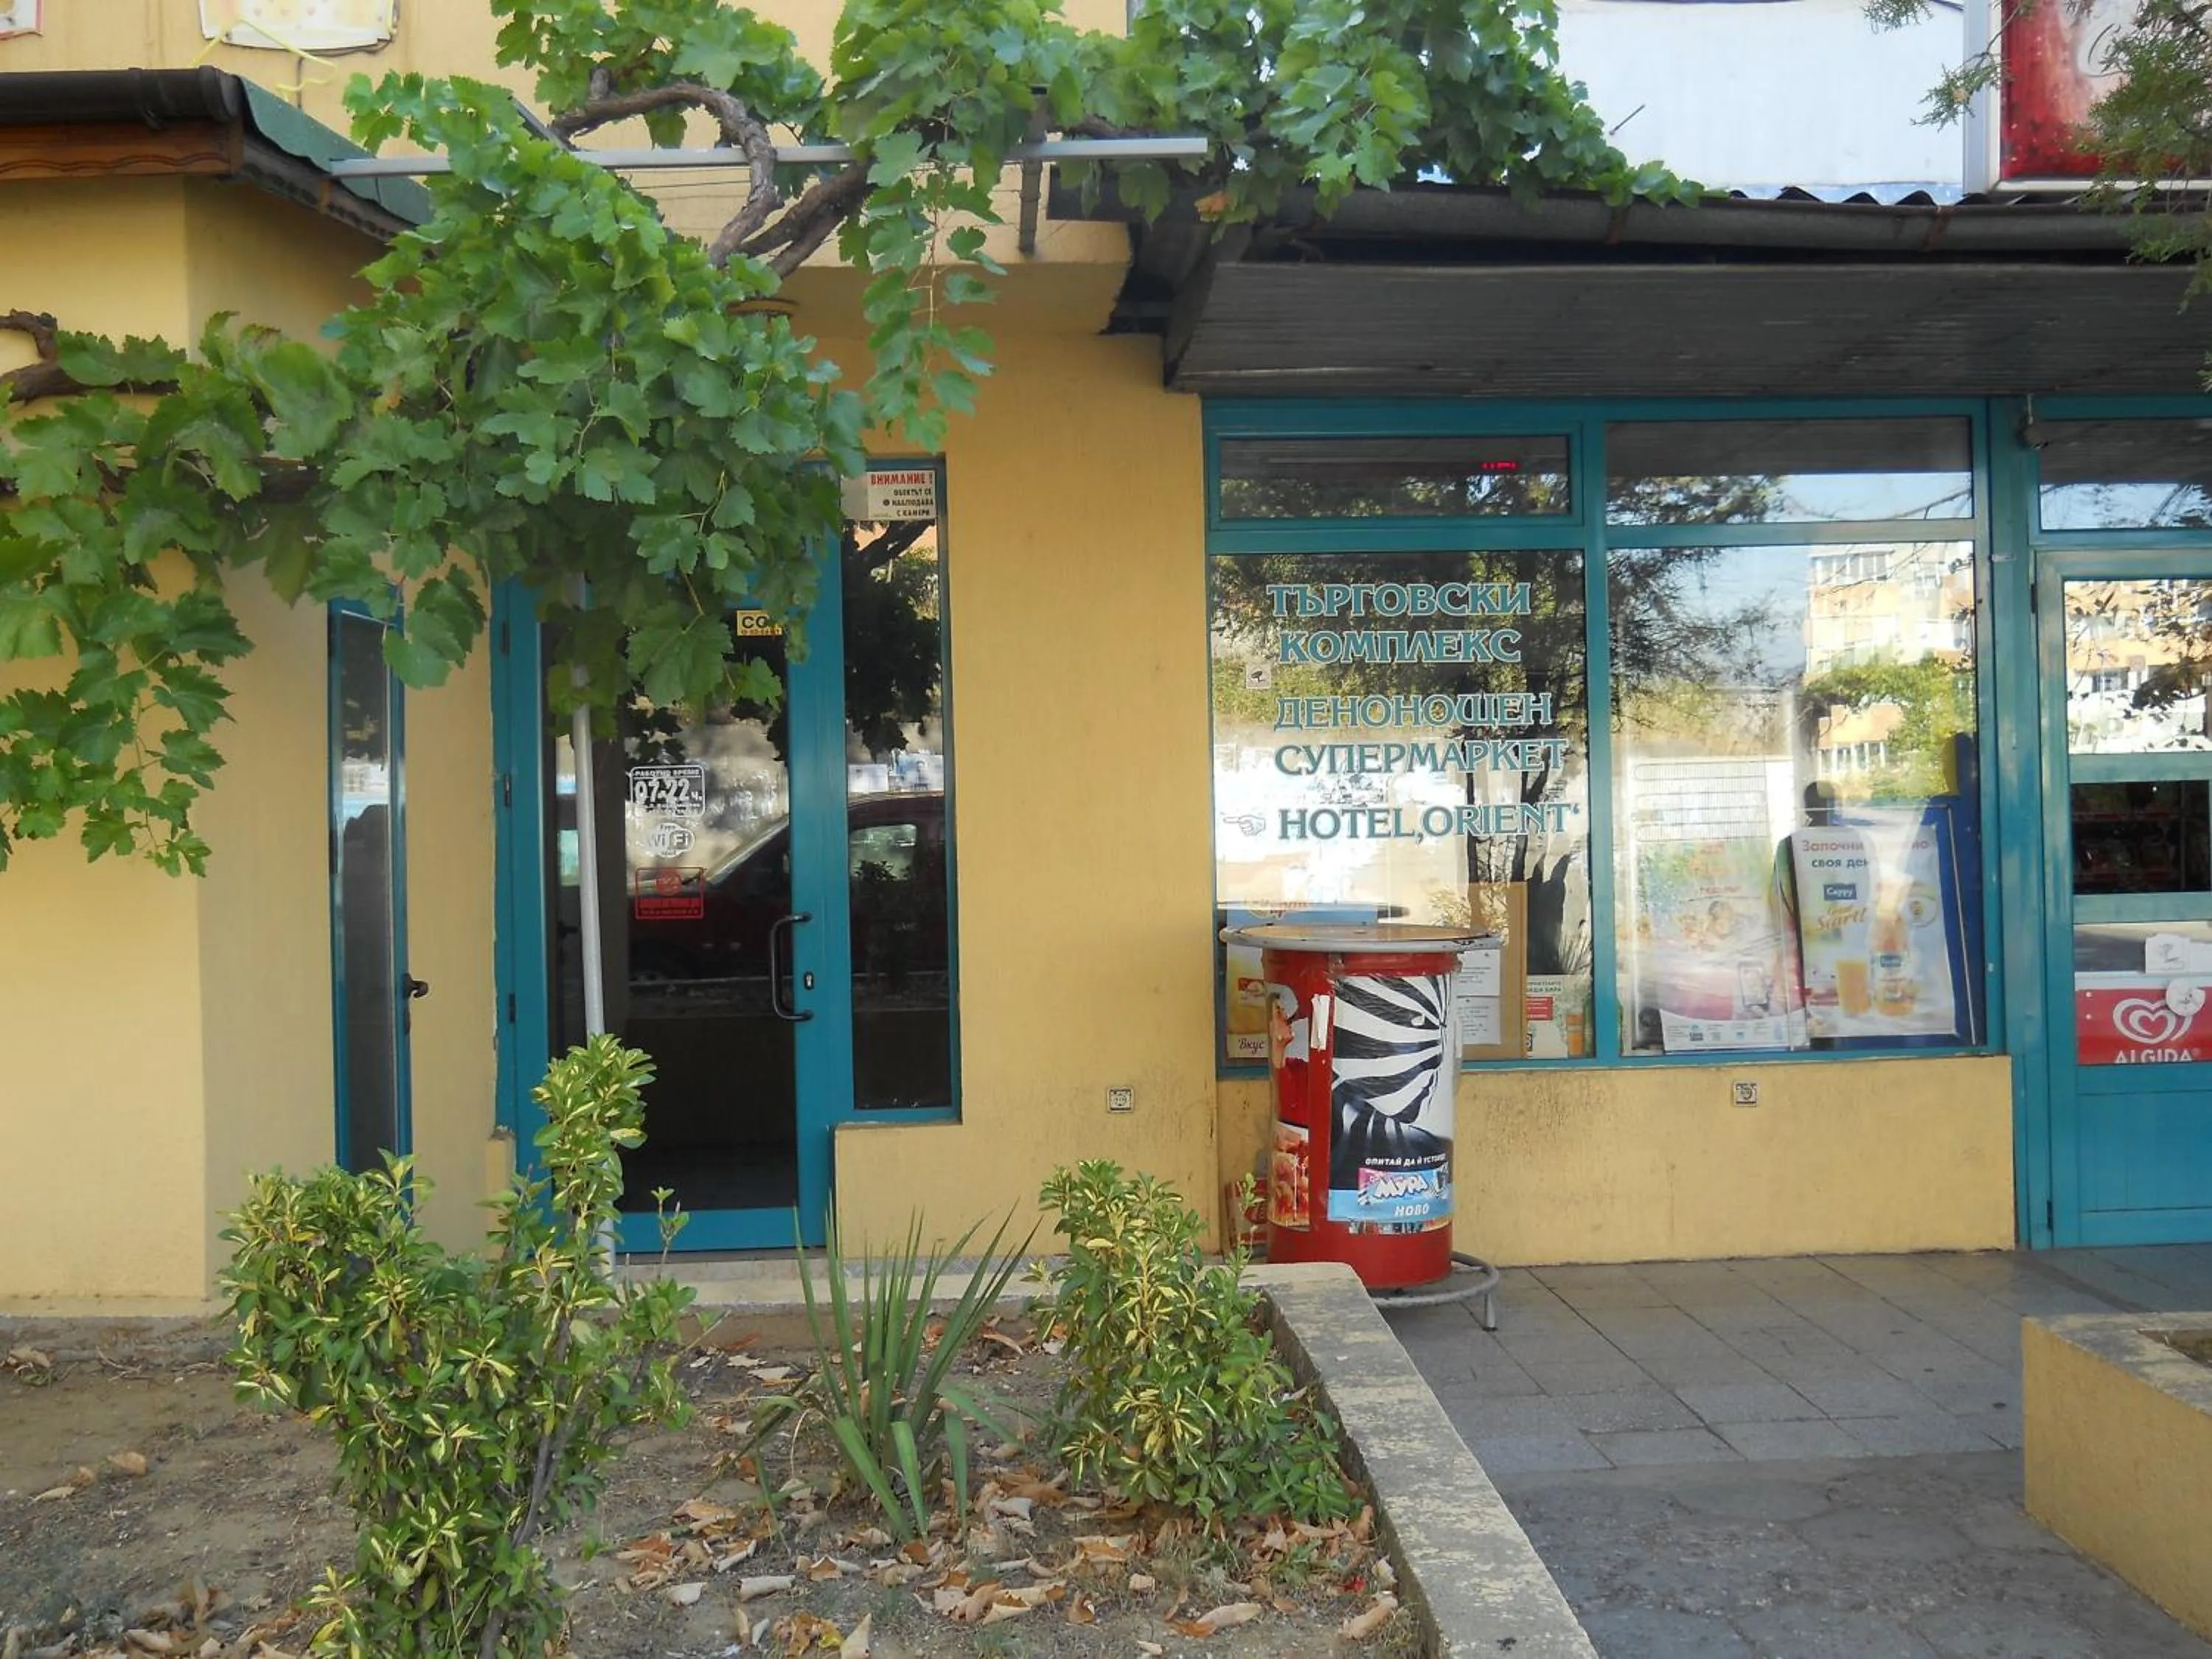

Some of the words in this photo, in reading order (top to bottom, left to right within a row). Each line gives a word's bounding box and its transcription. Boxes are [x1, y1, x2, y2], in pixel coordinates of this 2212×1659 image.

[871, 473, 926, 484] ВНИМАНИЕ
[1267, 582, 1531, 617] ТЪРГОВСКИ
[1279, 629, 1522, 664] КОМПЛЕКС
[1274, 693, 1553, 731] ДЕНОНОЩЕН
[1274, 739, 1568, 776] СУПЕРМАРКЕТ
[1802, 840, 1865, 852] Започни
[1238, 1037, 1265, 1054] Вкус
[1365, 1156, 1402, 1166] ОПИТАЙ
[1403, 1158, 1415, 1167] ДА
[1394, 1203, 1430, 1217] НОВО
